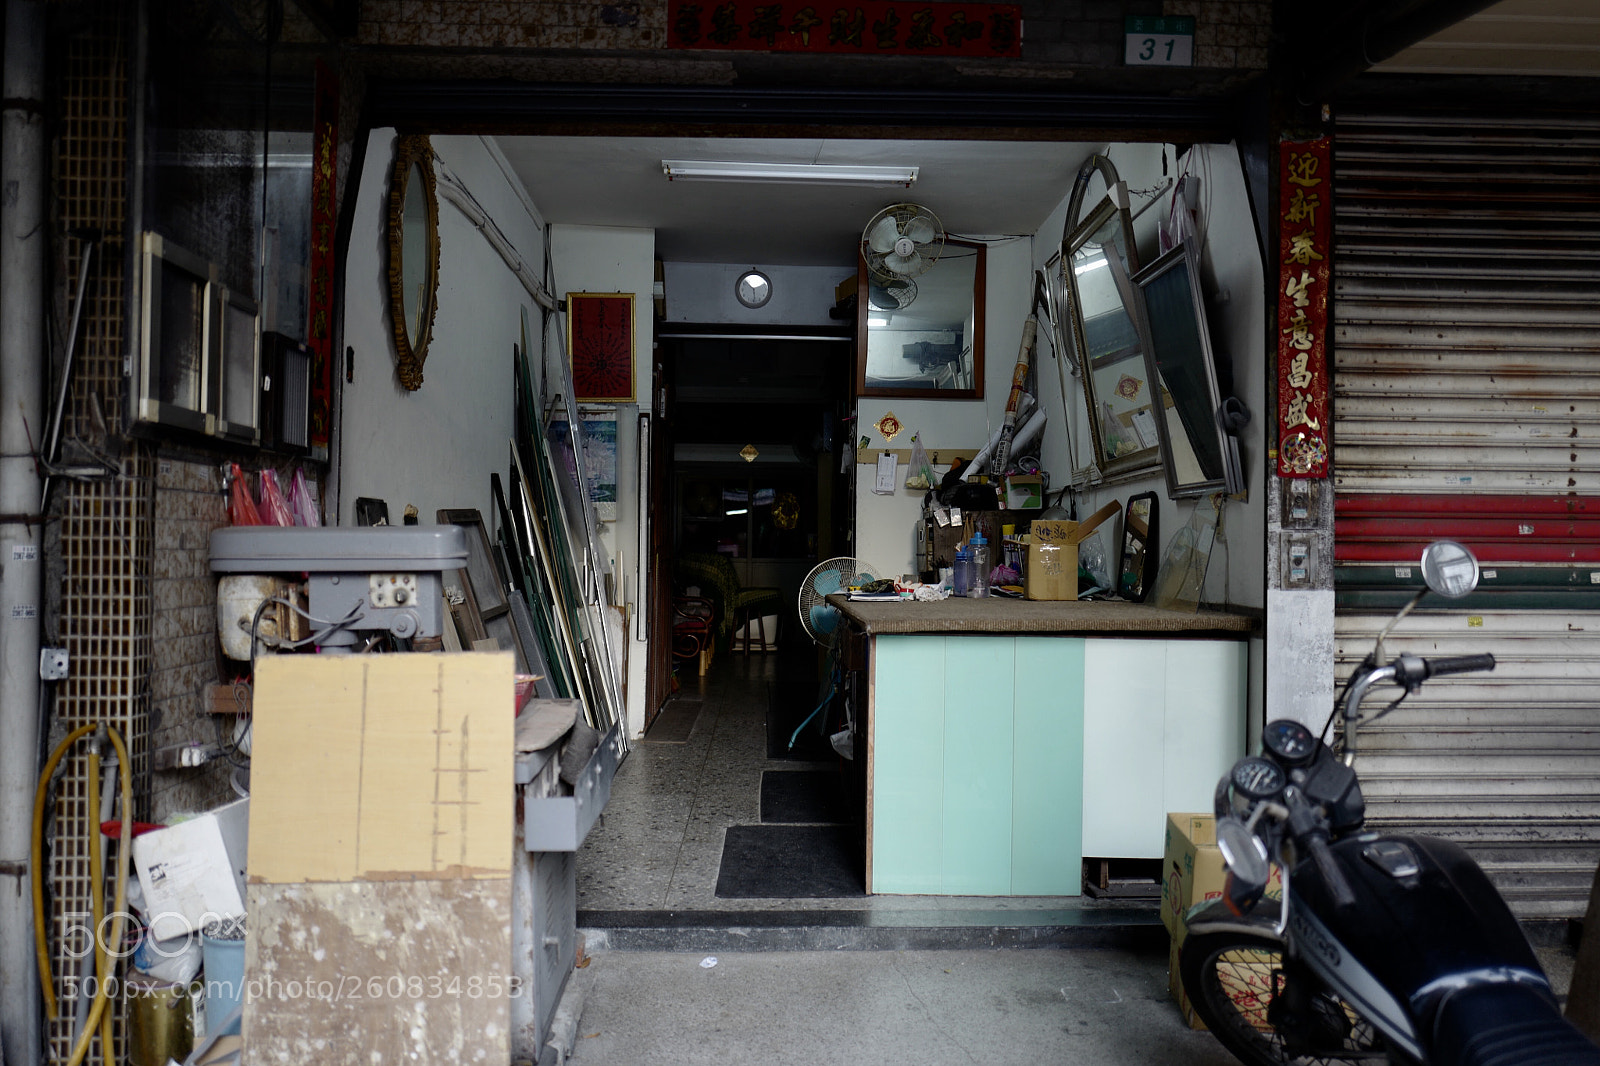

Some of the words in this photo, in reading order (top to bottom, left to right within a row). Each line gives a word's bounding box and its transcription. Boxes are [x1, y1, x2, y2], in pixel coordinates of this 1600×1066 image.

[1140, 38, 1174, 61] 31
[1283, 152, 1323, 432] 迎新春生意昌盛
